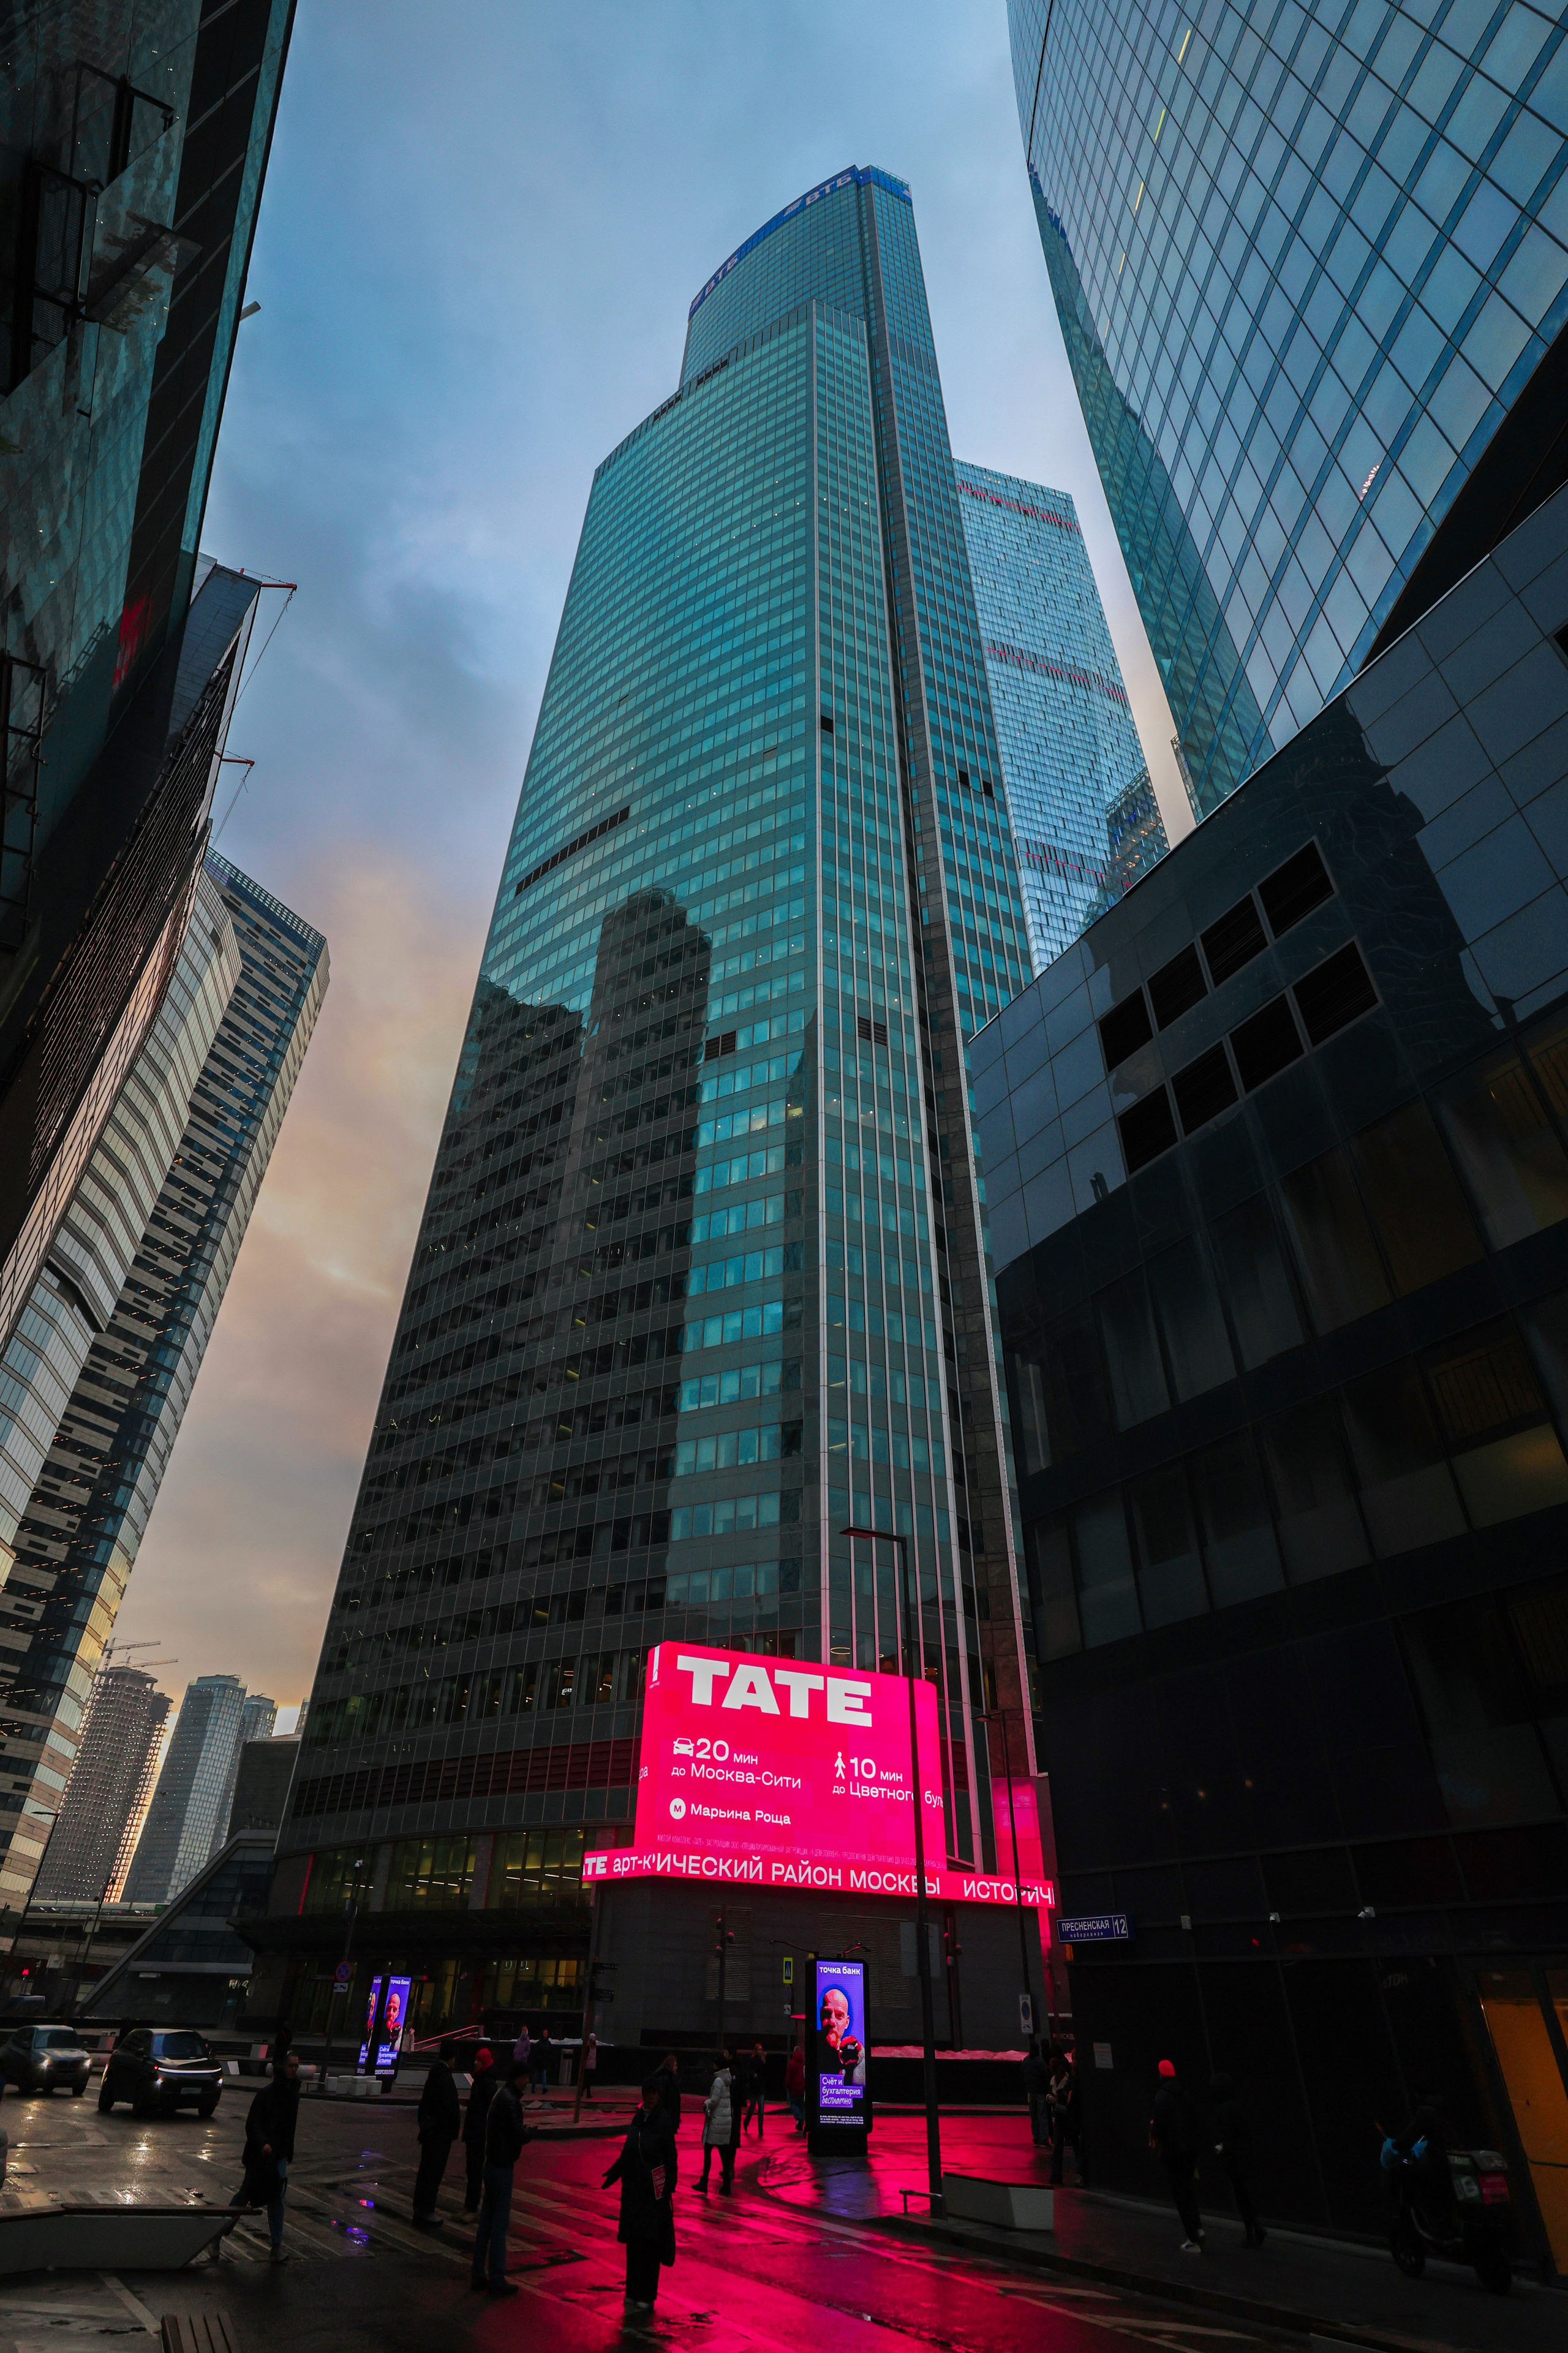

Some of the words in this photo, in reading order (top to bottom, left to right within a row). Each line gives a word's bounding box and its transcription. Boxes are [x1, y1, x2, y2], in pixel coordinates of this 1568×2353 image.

[677, 1655, 872, 1727] TATE
[696, 1739, 729, 1761] 20
[734, 1753, 758, 1764] мин
[671, 1767, 685, 1776] до
[692, 1763, 801, 1789] Москва-Сити
[850, 1758, 875, 1778] 10
[881, 1771, 902, 1781] мин
[833, 1786, 845, 1794] до
[691, 1803, 750, 1820] Марьина
[756, 1810, 791, 1826] Роща
[583, 1856, 607, 1875] TE
[652, 1853, 762, 1879] ИЧЕСКИЙ
[772, 1860, 841, 1886] РАЙОН
[964, 1880, 1054, 1904] ИСТОИЧ
[1062, 1920, 1109, 1932] ПРЕСНЕНСКАЯ
[1115, 1919, 1126, 1934] 12
[822, 2077, 837, 2085] Счёт
[822, 2086, 861, 2096] бухгалтерия
[822, 2095, 851, 2105] бесплатно
